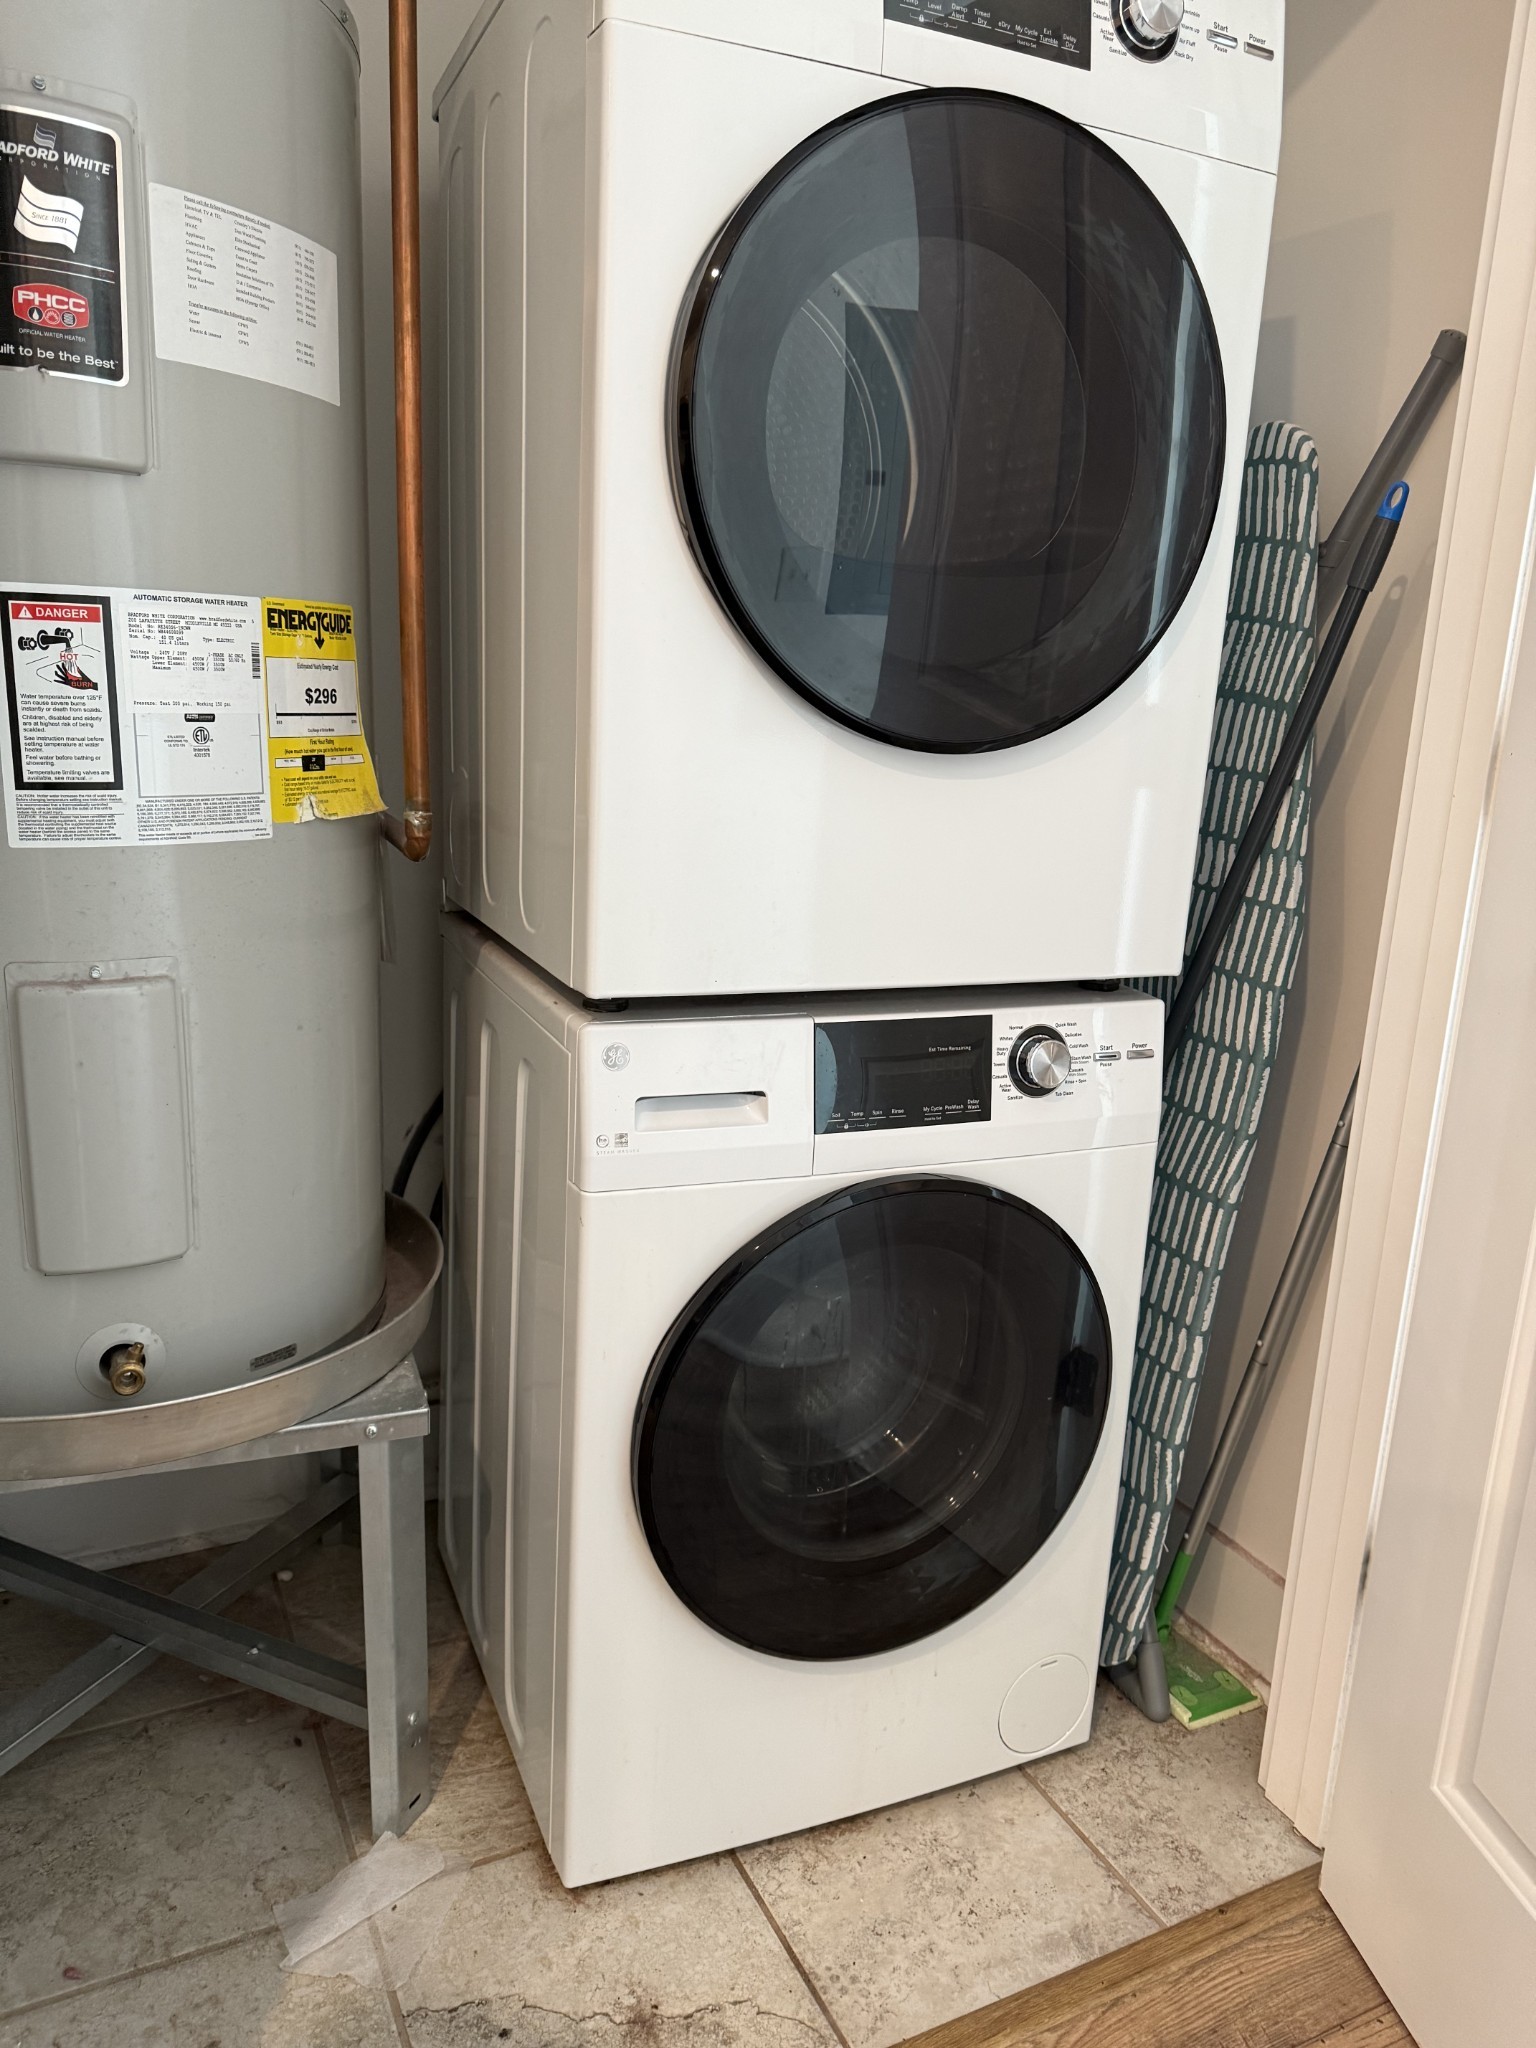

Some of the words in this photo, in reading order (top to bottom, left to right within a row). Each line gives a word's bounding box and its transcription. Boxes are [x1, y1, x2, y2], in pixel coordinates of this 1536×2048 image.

[927, 1, 942, 11] Level
[951, 3, 968, 13] Damp
[951, 11, 965, 20] Alert
[974, 8, 991, 18] Timed
[1092, 12, 1110, 22] Casuals
[977, 17, 988, 27] Dry
[998, 21, 1011, 30] eDry
[1213, 21, 1229, 33] Start
[1015, 24, 1023, 33] My
[1023, 26, 1038, 37] Cycle
[1043, 27, 1052, 35] Ext
[1100, 28, 1115, 37] Active
[1040, 34, 1059, 46] Tumble
[1063, 33, 1077, 44] Delay
[1185, 39, 1196, 47] Fluff
[1248, 33, 1267, 45] Power
[1065, 41, 1075, 51] Dry
[1213, 43, 1228, 54] Pause
[1173, 50, 1185, 58] Rack
[1185, 53, 1194, 62] Dry
[17, 289, 86, 313] PHCC
[18, 327, 42, 336] OFFICIAL
[43, 331, 64, 339] WATER
[64, 335, 86, 343] HEATER
[18, 345, 33, 357] to
[37, 347, 55, 360] be
[58, 351, 81, 364] the
[133, 594, 172, 602] AUTOMATIC
[173, 596, 204, 604] STORAGE
[225, 600, 248, 608] HEATER
[35, 607, 88, 620] DANGER
[267, 607, 352, 641] ENERGYGUIDE
[60, 653, 79, 662] HOT
[71, 681, 93, 689] BURN
[305, 687, 337, 706] $296
